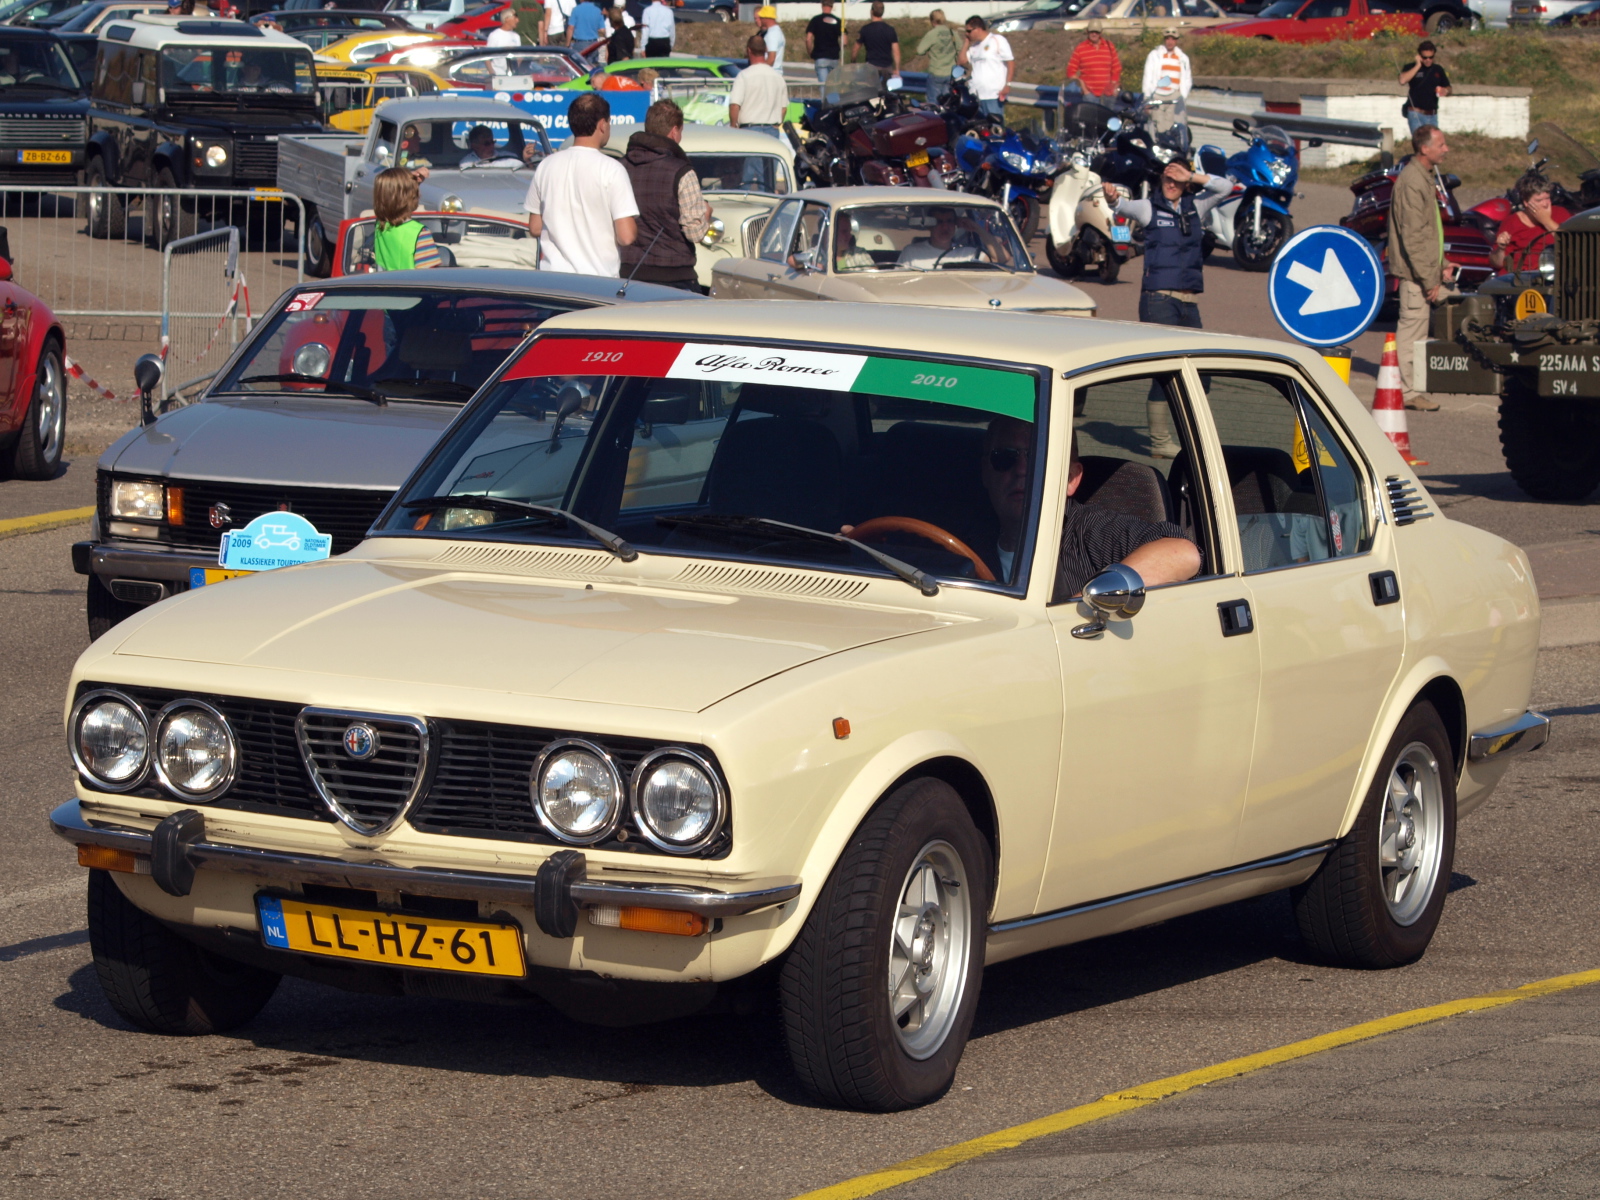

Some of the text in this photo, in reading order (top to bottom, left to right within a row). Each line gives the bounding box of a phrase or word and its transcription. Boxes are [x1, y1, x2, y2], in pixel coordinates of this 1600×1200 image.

[26, 152, 67, 162] ZB-BZ-66
[581, 351, 958, 388] 1910 Alfa Romeo 2010
[1429, 355, 1469, 371] 82A/BX
[1539, 354, 1587, 372] 225AAA
[1552, 379, 1578, 395] SV 4
[232, 539, 252, 548] 2009
[240, 557, 275, 567] KLASSIEKER
[267, 924, 285, 939] NL
[305, 910, 496, 967] LL-HZ-61
